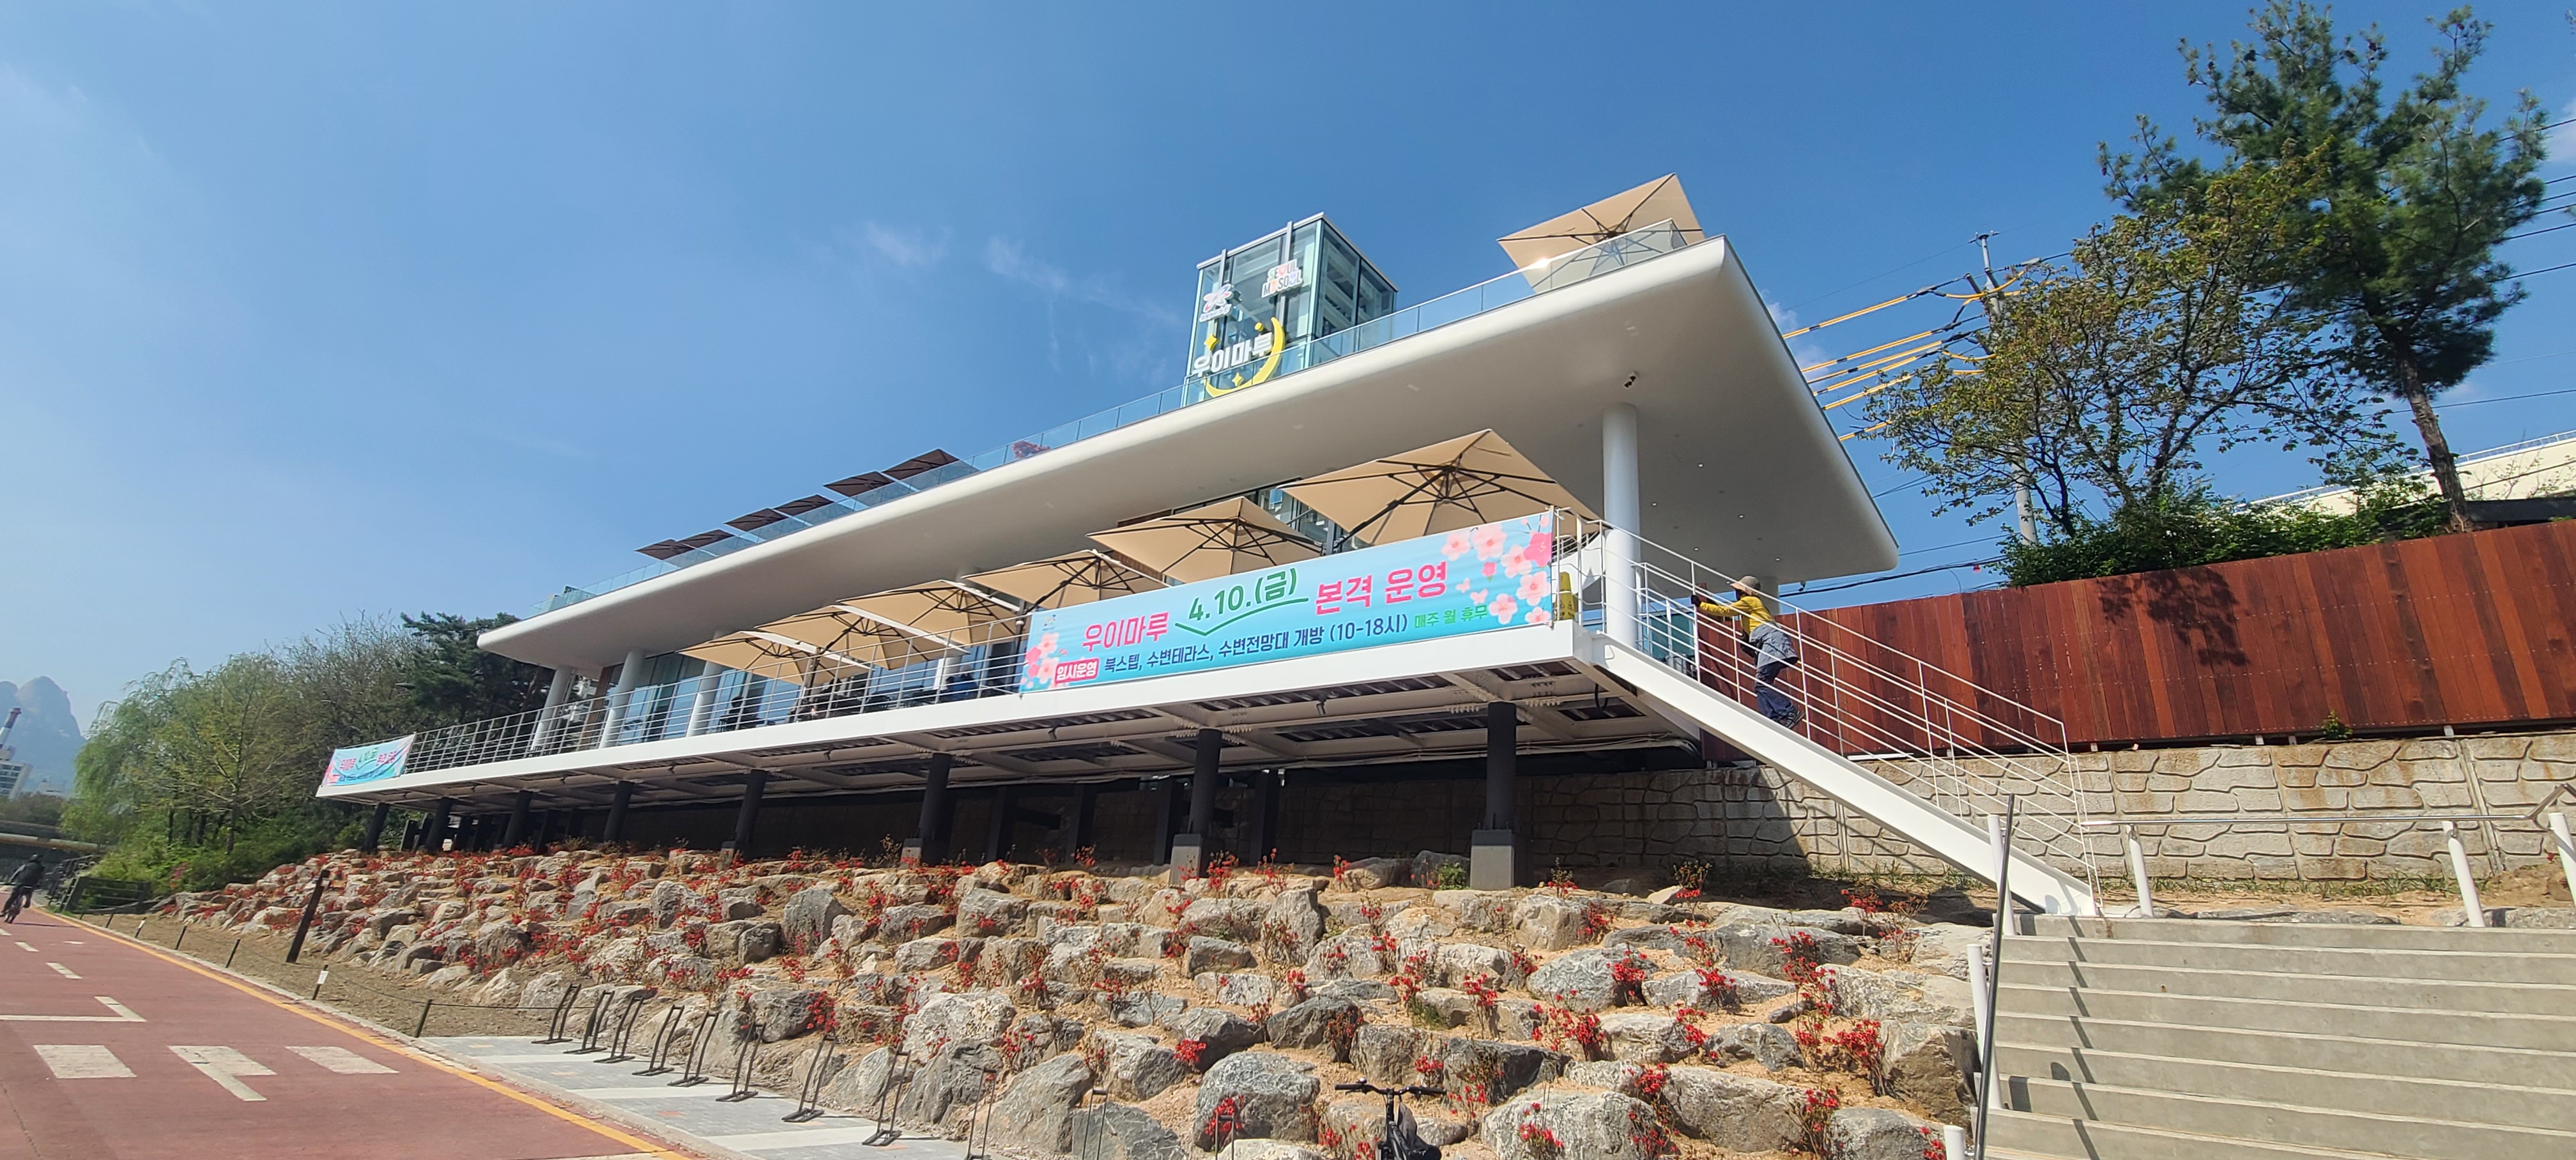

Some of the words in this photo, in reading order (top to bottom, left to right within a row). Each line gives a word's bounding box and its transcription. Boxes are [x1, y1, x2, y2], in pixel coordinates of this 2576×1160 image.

[1192, 332, 1272, 378] 우이마루
[1082, 611, 1170, 652] 우이마루
[1188, 567, 1297, 621] 4.10.(금)
[1314, 575, 1373, 616] 본격
[1384, 561, 1448, 604] 운영
[1414, 612, 1439, 629] 매주
[1443, 609, 1457, 624] 월
[1460, 604, 1488, 622] 휴무
[1147, 644, 1214, 668] 수변테라스,
[1218, 630, 1289, 658] 수변전망대
[1293, 626, 1324, 647] 개방
[1330, 613, 1408, 643] (10-18시)
[1055, 662, 1098, 682] 임시운영
